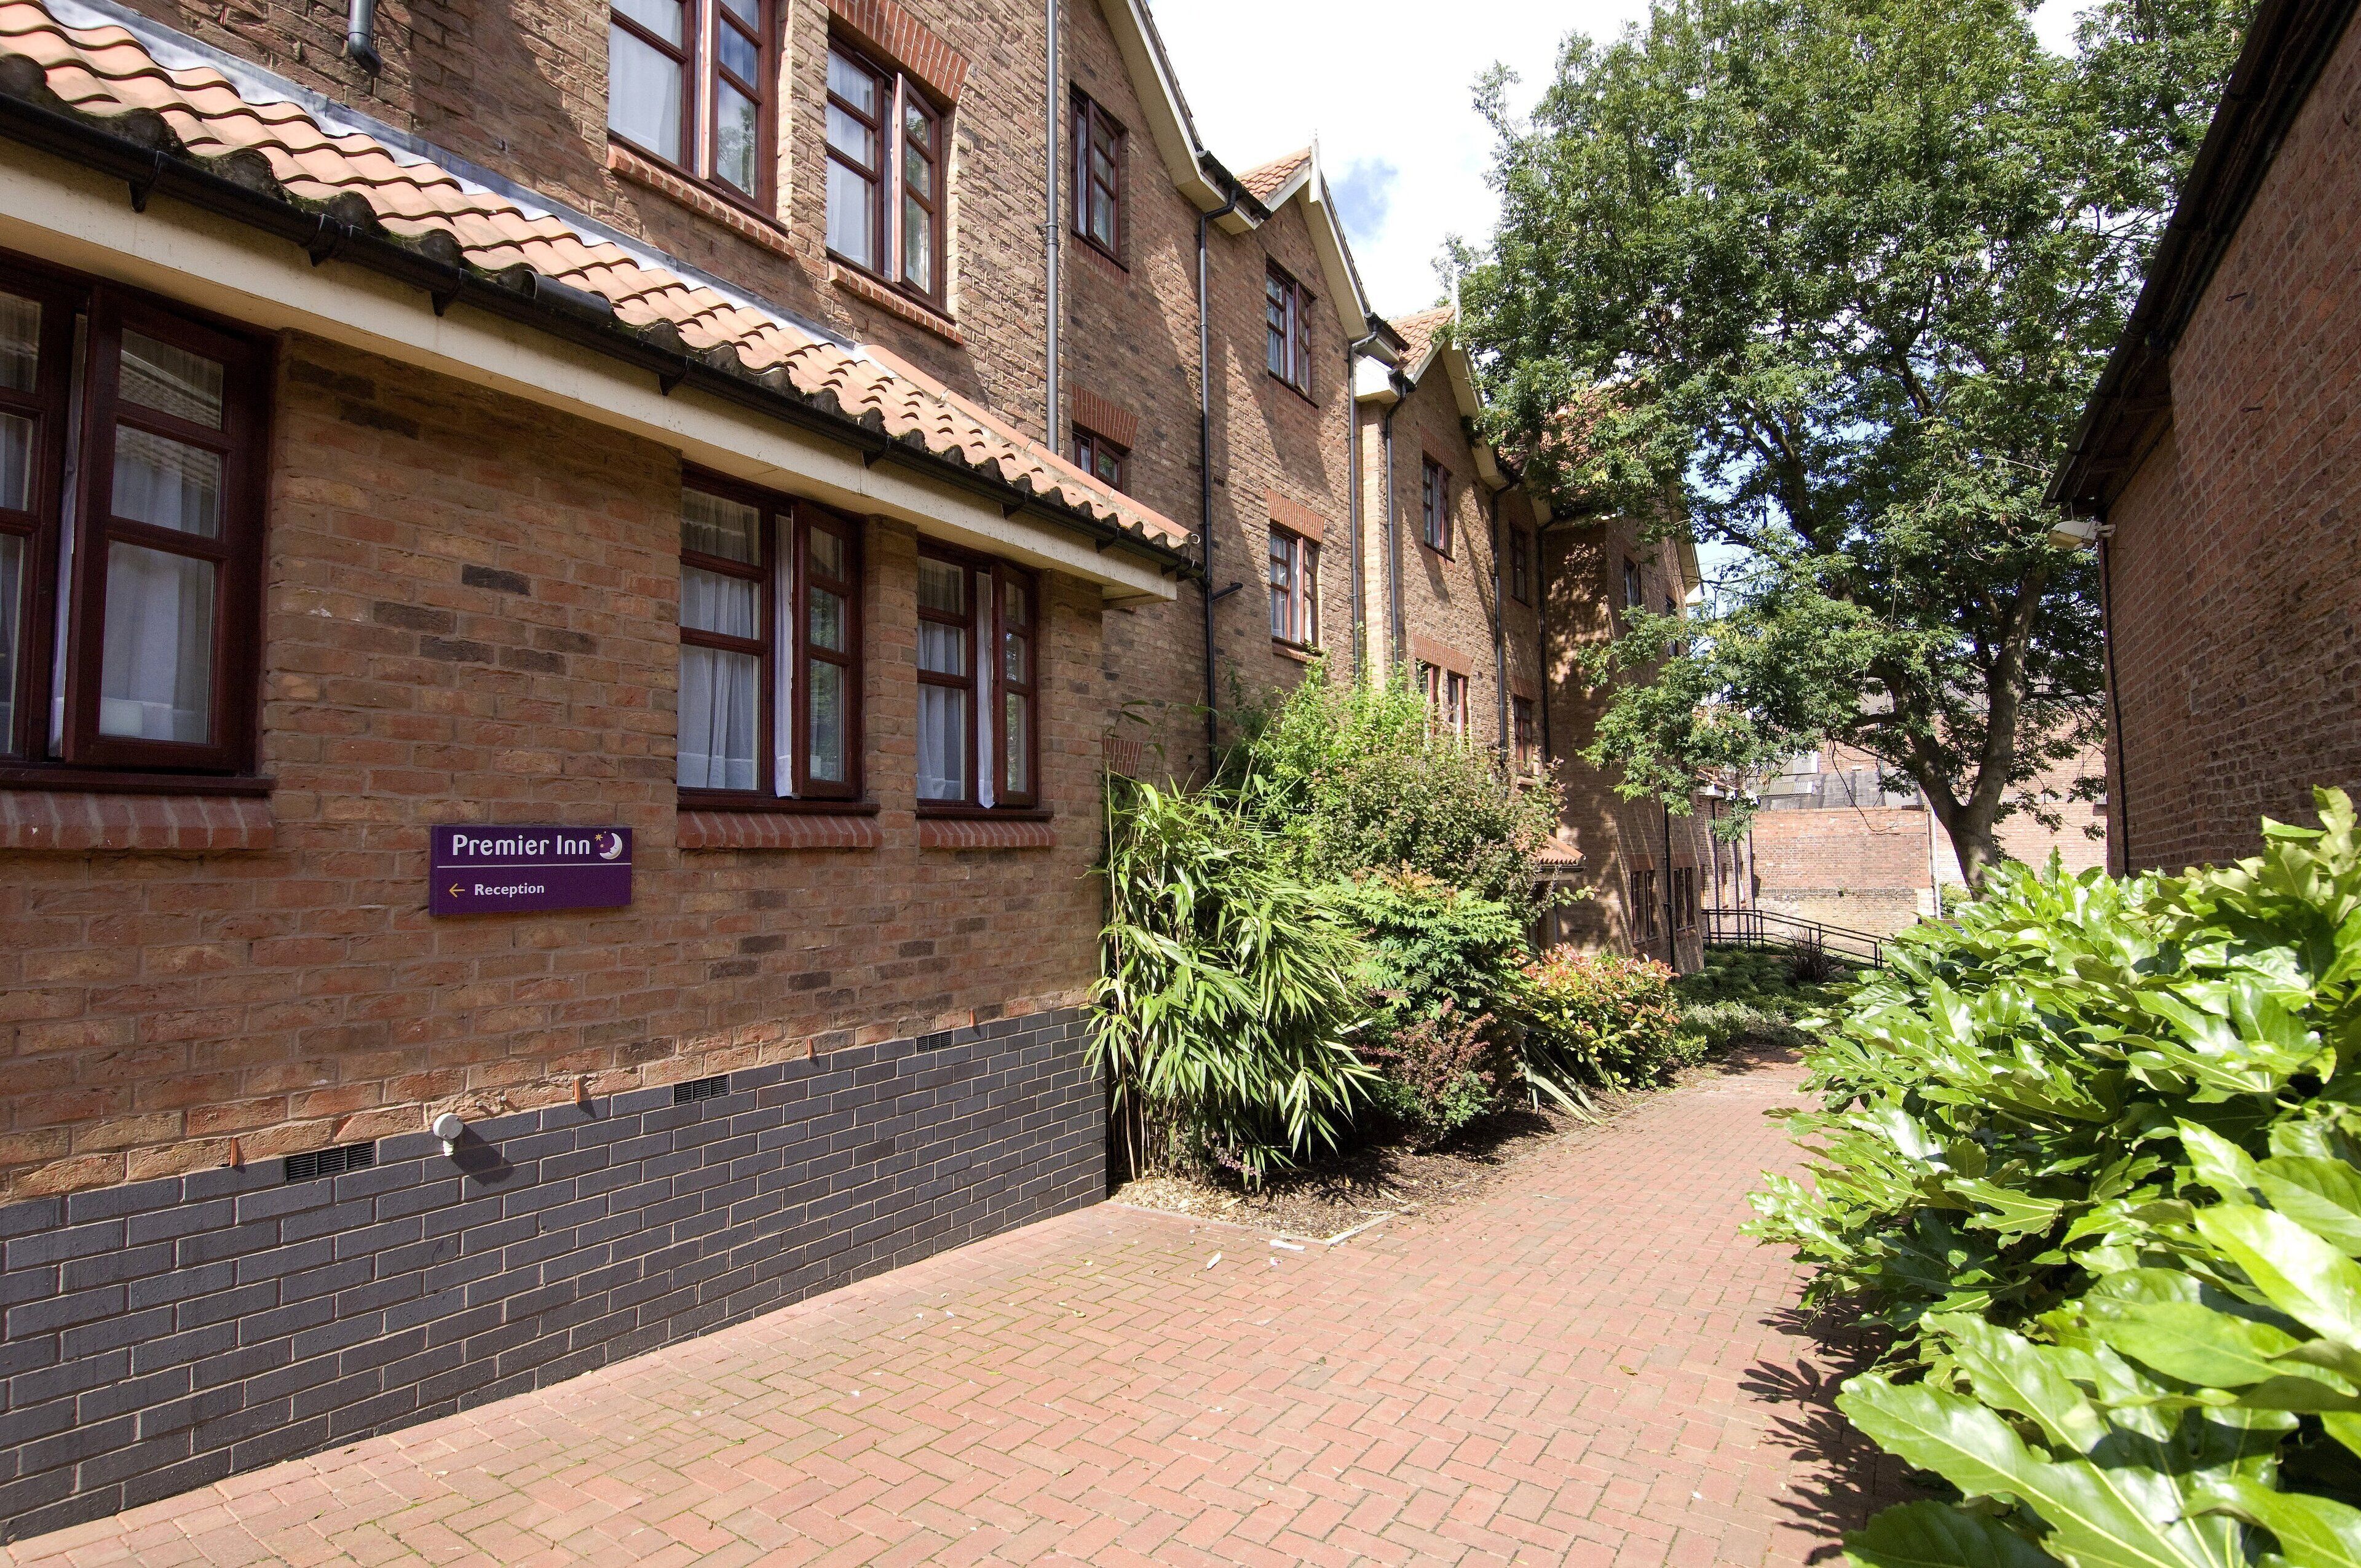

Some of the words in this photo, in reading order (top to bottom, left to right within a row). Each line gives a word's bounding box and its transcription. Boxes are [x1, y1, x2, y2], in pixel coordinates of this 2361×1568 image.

[453, 834, 549, 855] Premier
[557, 835, 590, 854] Inn
[475, 882, 544, 897] Reception
